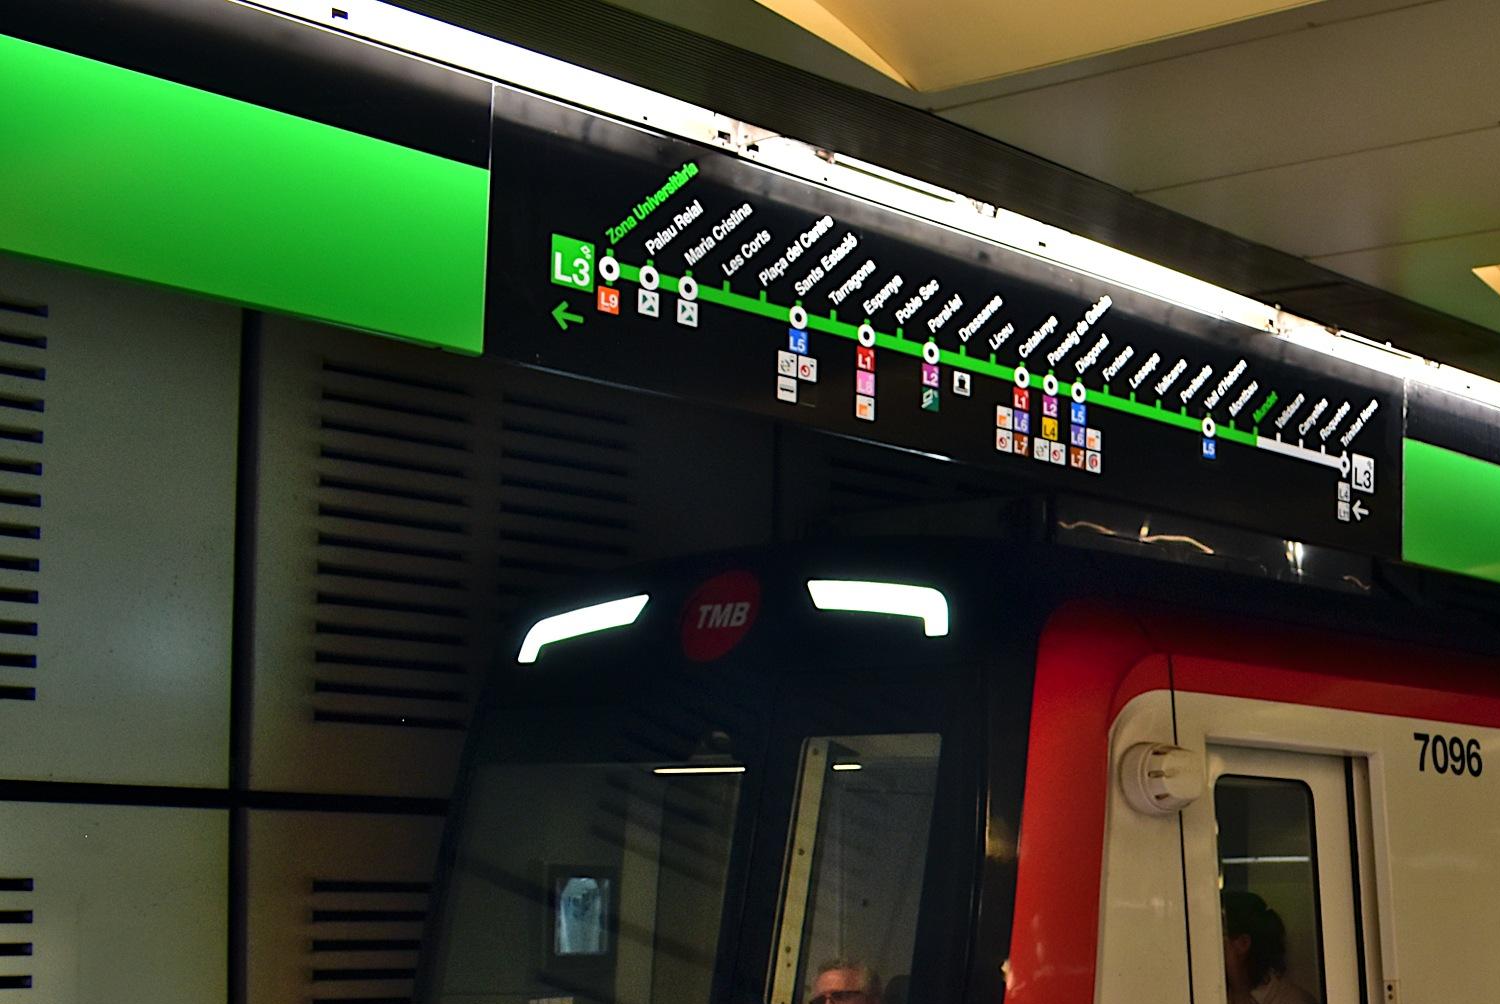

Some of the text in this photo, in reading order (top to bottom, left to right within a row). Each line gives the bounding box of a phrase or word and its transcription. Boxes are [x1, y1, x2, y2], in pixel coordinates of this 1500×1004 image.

[605, 215, 637, 245] Zona
[645, 199, 704, 255] Palau Reial
[683, 202, 753, 266] Maria Cristina
[722, 229, 771, 276] Les Corts
[759, 257, 788, 287] Plaça
[786, 240, 804, 263] del
[555, 252, 590, 287] L3
[795, 266, 825, 296] Sants
[828, 259, 876, 305] Tarragona
[601, 292, 618, 308] L9
[863, 275, 903, 315] Espanya
[895, 279, 940, 325] Poble Sec
[789, 335, 805, 352] L5
[989, 322, 1015, 350] Liceu
[858, 355, 872, 369] L1
[922, 370, 939, 386] L2
[1014, 396, 1026, 411] L1
[1043, 402, 1058, 417] L2
[1072, 409, 1085, 425] L5
[1043, 424, 1056, 438] L4
[1203, 441, 1216, 456] L5
[1354, 467, 1372, 489] L3
[697, 602, 751, 629] TMB
[1413, 732, 1483, 778] 7096
